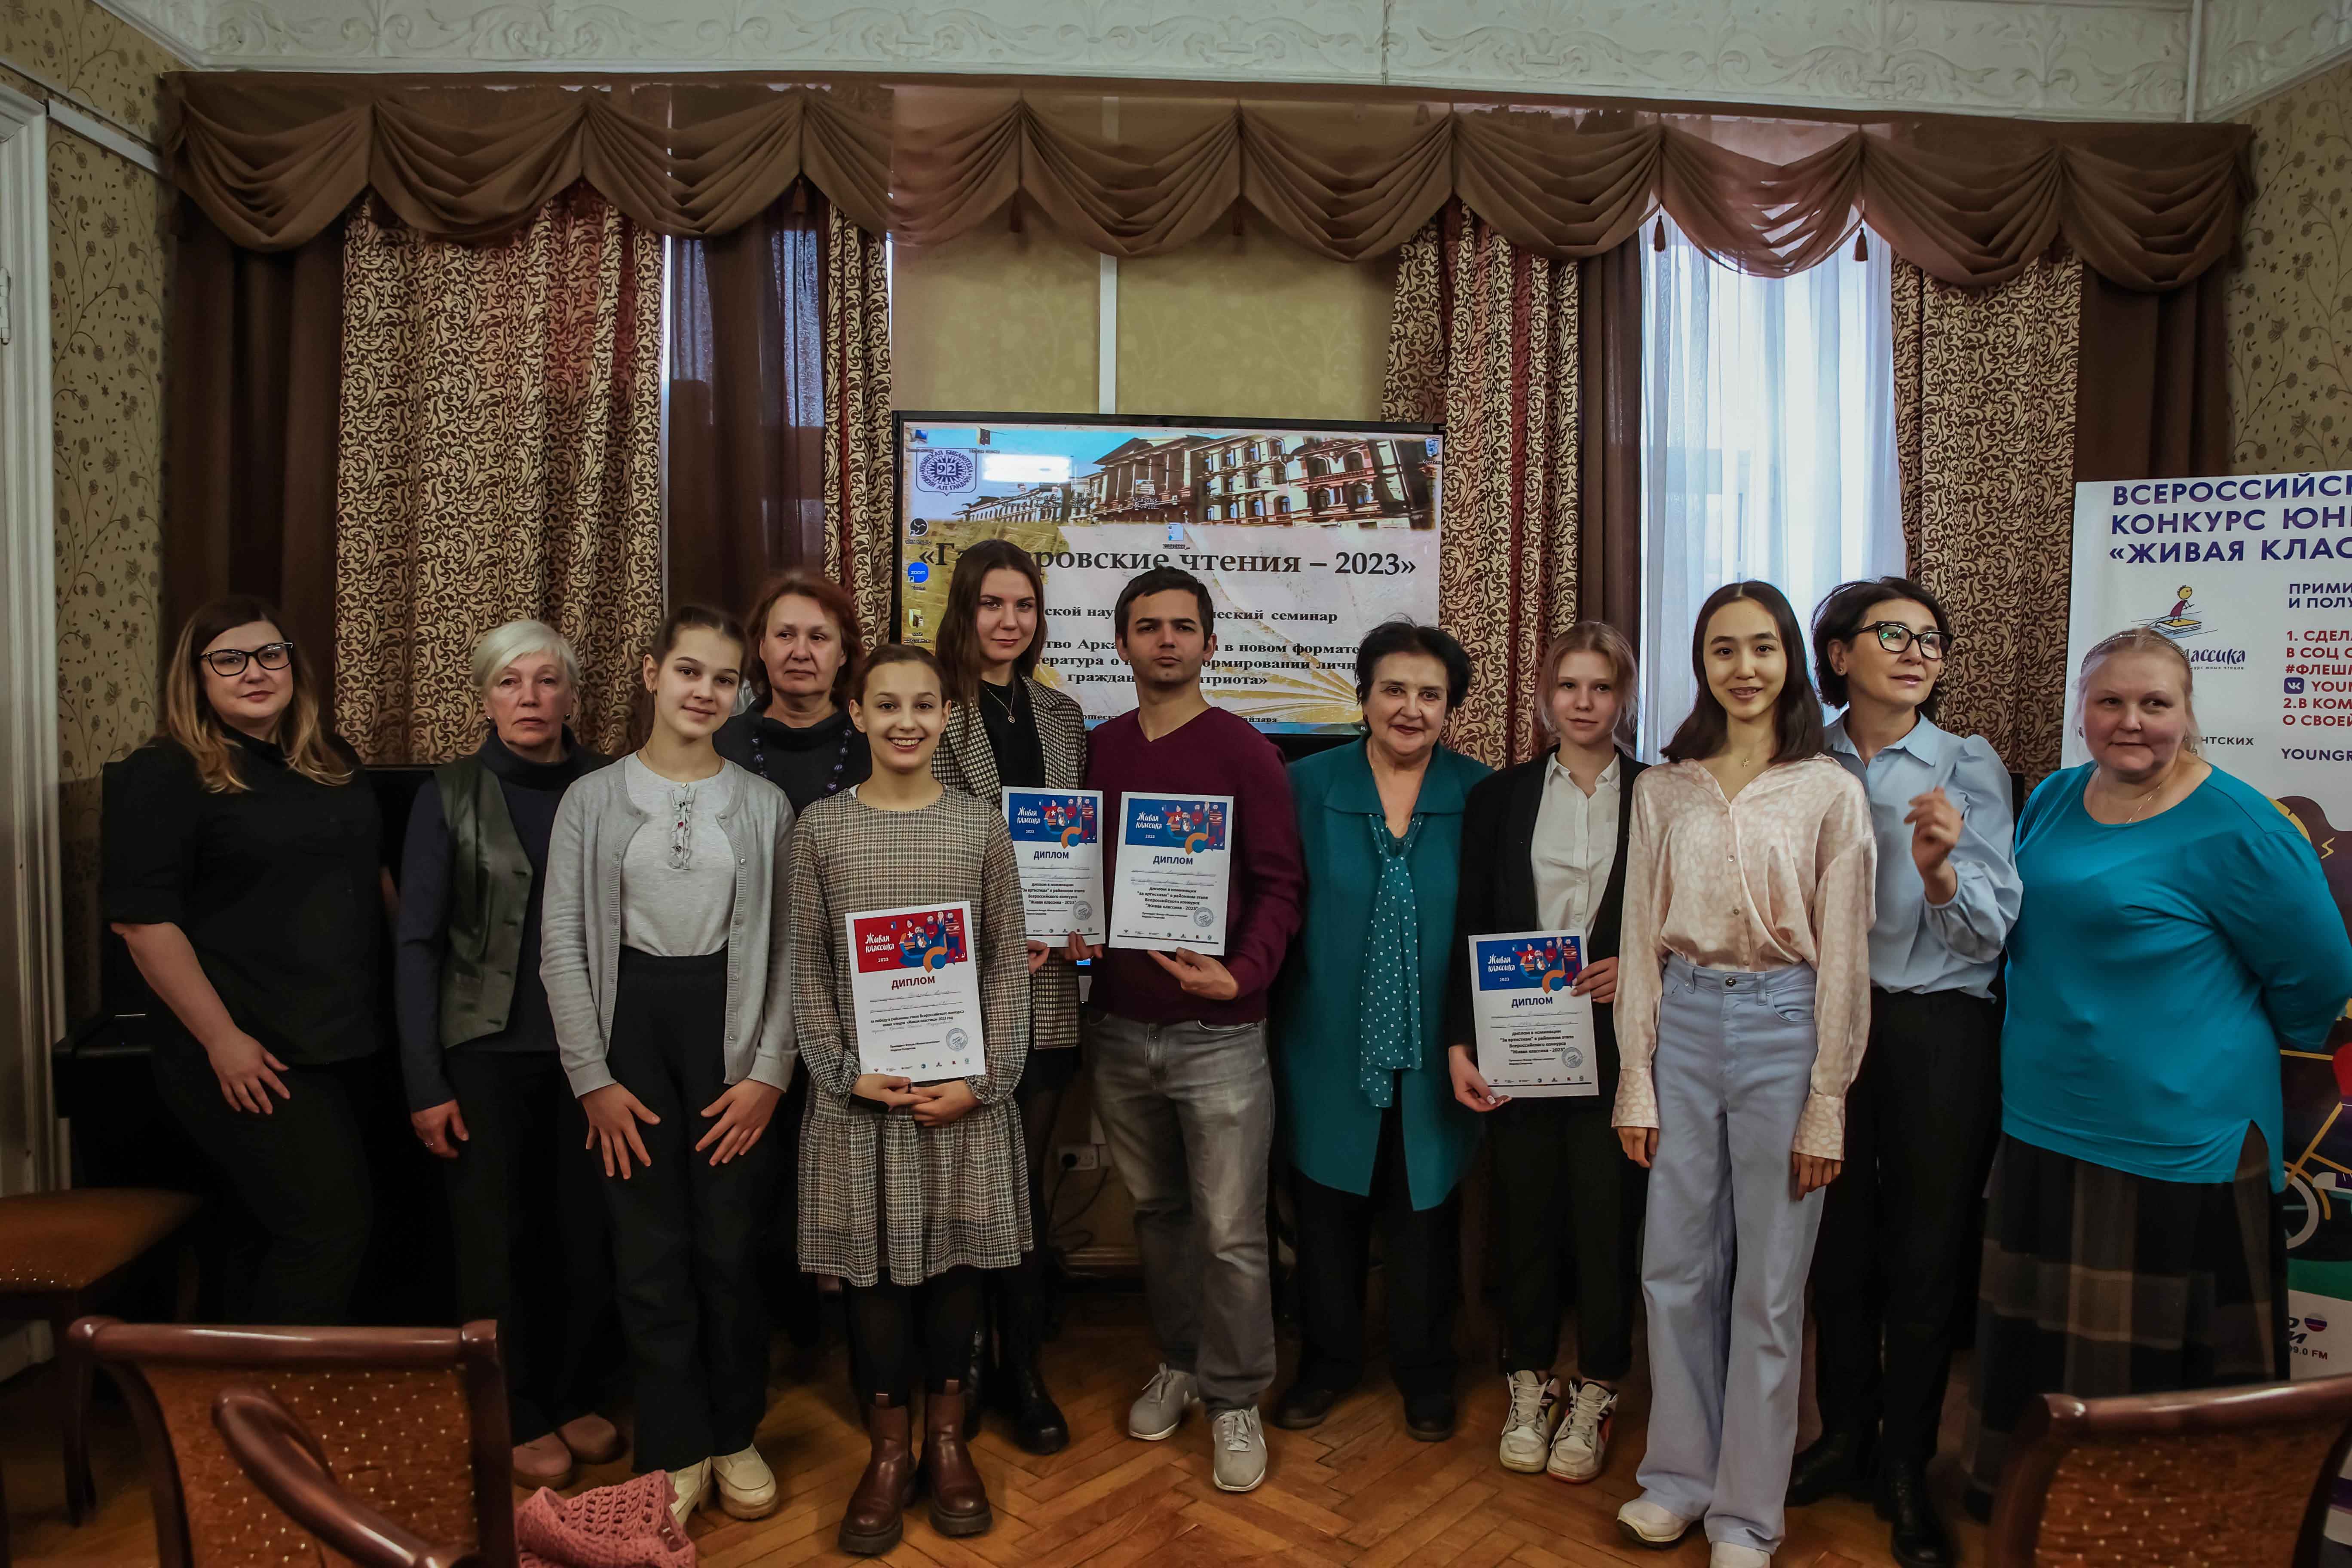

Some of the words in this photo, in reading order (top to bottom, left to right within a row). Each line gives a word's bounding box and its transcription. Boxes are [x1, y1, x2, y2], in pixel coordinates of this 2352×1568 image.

[2111, 509, 2266, 535] КОНКУРС
[2282, 505, 2352, 530] ЮН
[2109, 540, 2245, 564] «ЖИВАЯ
[1179, 554, 1302, 573] чтения
[1335, 552, 1417, 575] 2023»
[2288, 597, 2300, 608] И
[1045, 606, 1081, 616] ской
[1271, 612, 1338, 624] семинар
[2286, 631, 2298, 641] 1.
[2304, 630, 2352, 643] СДЕЛ
[1292, 643, 1359, 655] формате
[2286, 647, 2295, 658] В
[2300, 647, 2339, 660] СОЦ
[2282, 714, 2295, 726] О
[1017, 806, 1037, 816] Живая
[1136, 811, 1159, 822] Живая
[1033, 851, 1069, 860] ДИПЛОМ
[1153, 856, 1193, 865] ДИПЛОМ
[865, 932, 890, 944] Живая
[866, 943, 894, 953] классика
[1488, 954, 1511, 964] Живая
[1488, 965, 1515, 973] классика
[891, 976, 935, 990] ДИПЛОМ
[1511, 997, 1553, 1008] ДИПЛОМ
